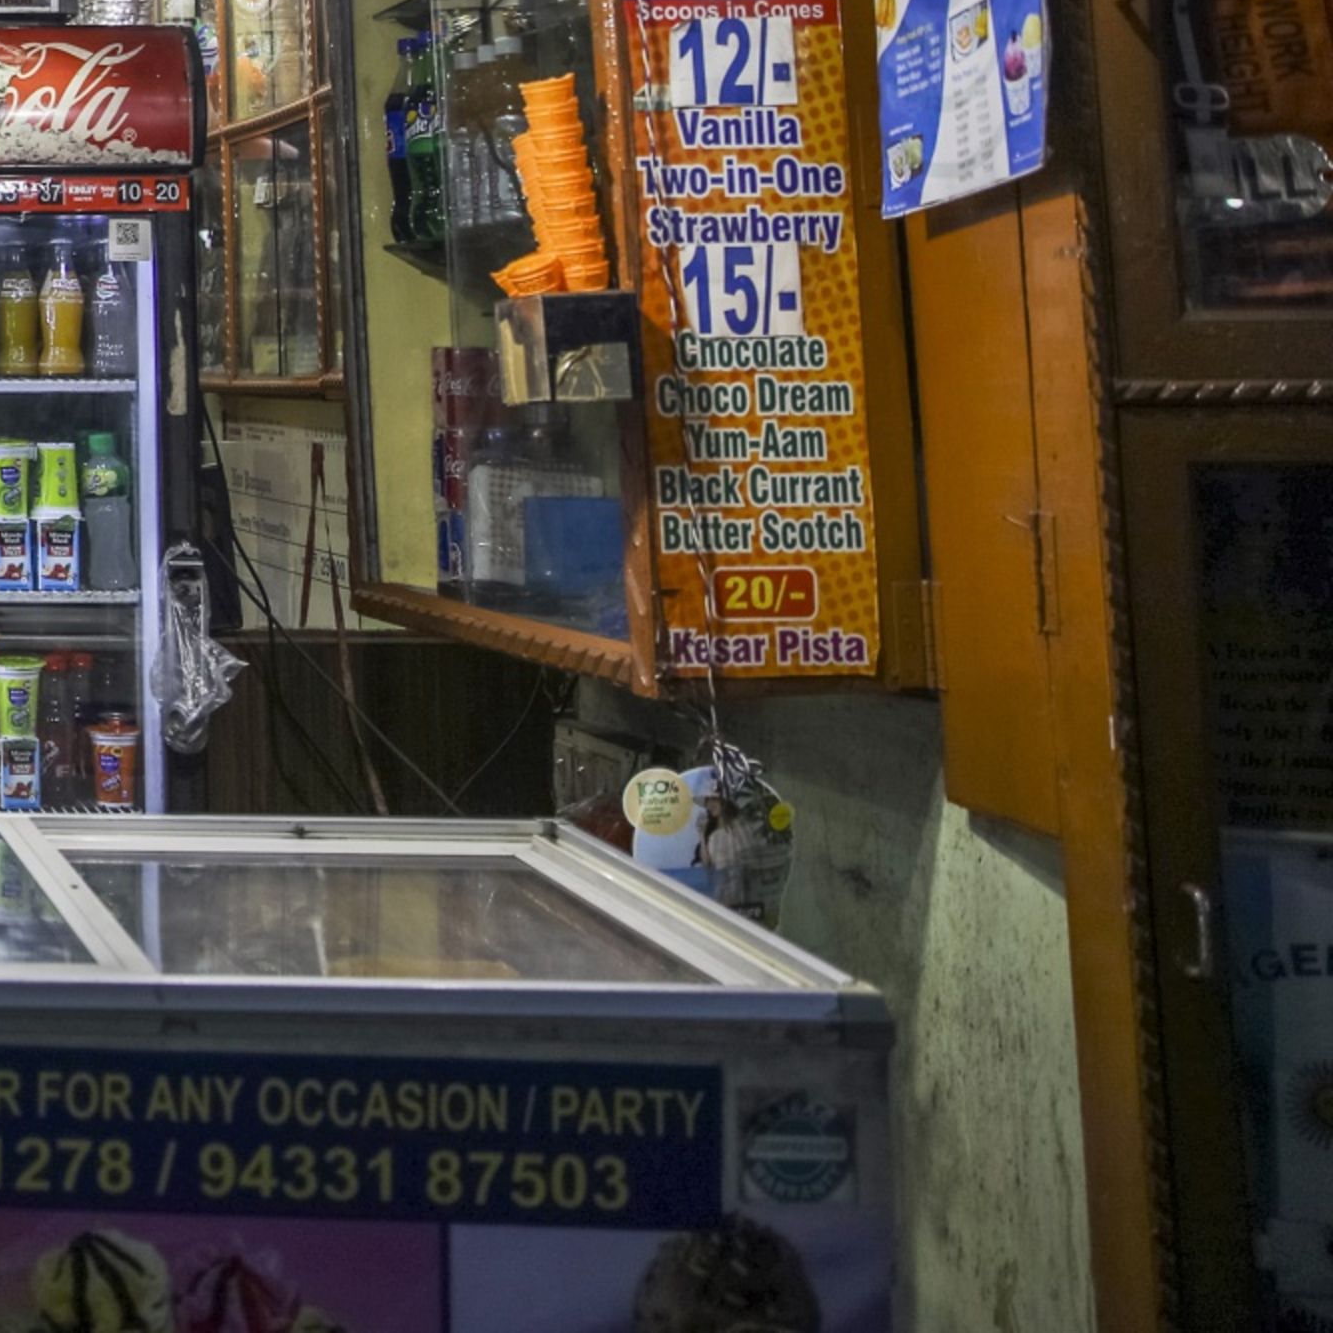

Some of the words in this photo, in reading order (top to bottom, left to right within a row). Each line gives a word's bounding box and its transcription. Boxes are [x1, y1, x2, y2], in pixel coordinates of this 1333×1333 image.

[637, 0, 720, 21] Scoops
[727, 0, 747, 18] in
[754, 0, 825, 19] Cones
[676, 108, 803, 149] Vanilla
[118, 183, 141, 201] 10
[155, 182, 180, 201] 20
[638, 160, 844, 198] Two-in-One
[648, 206, 844, 253] Strawberry
[678, 331, 828, 371] Chocolate
[656, 376, 749, 418] Choco
[756, 376, 854, 416] Dream
[686, 420, 827, 461] Yum-Aam
[656, 466, 747, 509] Black
[747, 466, 864, 508] Currant
[661, 512, 753, 554] Butter
[762, 511, 865, 552] Scotch
[724, 575, 807, 614] 20/-
[671, 629, 767, 667] Kesar
[777, 629, 868, 666] Pista
[37, 1070, 132, 1122] FOR
[145, 1074, 244, 1124] ANY
[257, 1077, 509, 1134] OCCASION
[549, 1087, 706, 1140] PARTY
[198, 1142, 395, 1204] 94331
[426, 1152, 631, 1210] 87503
